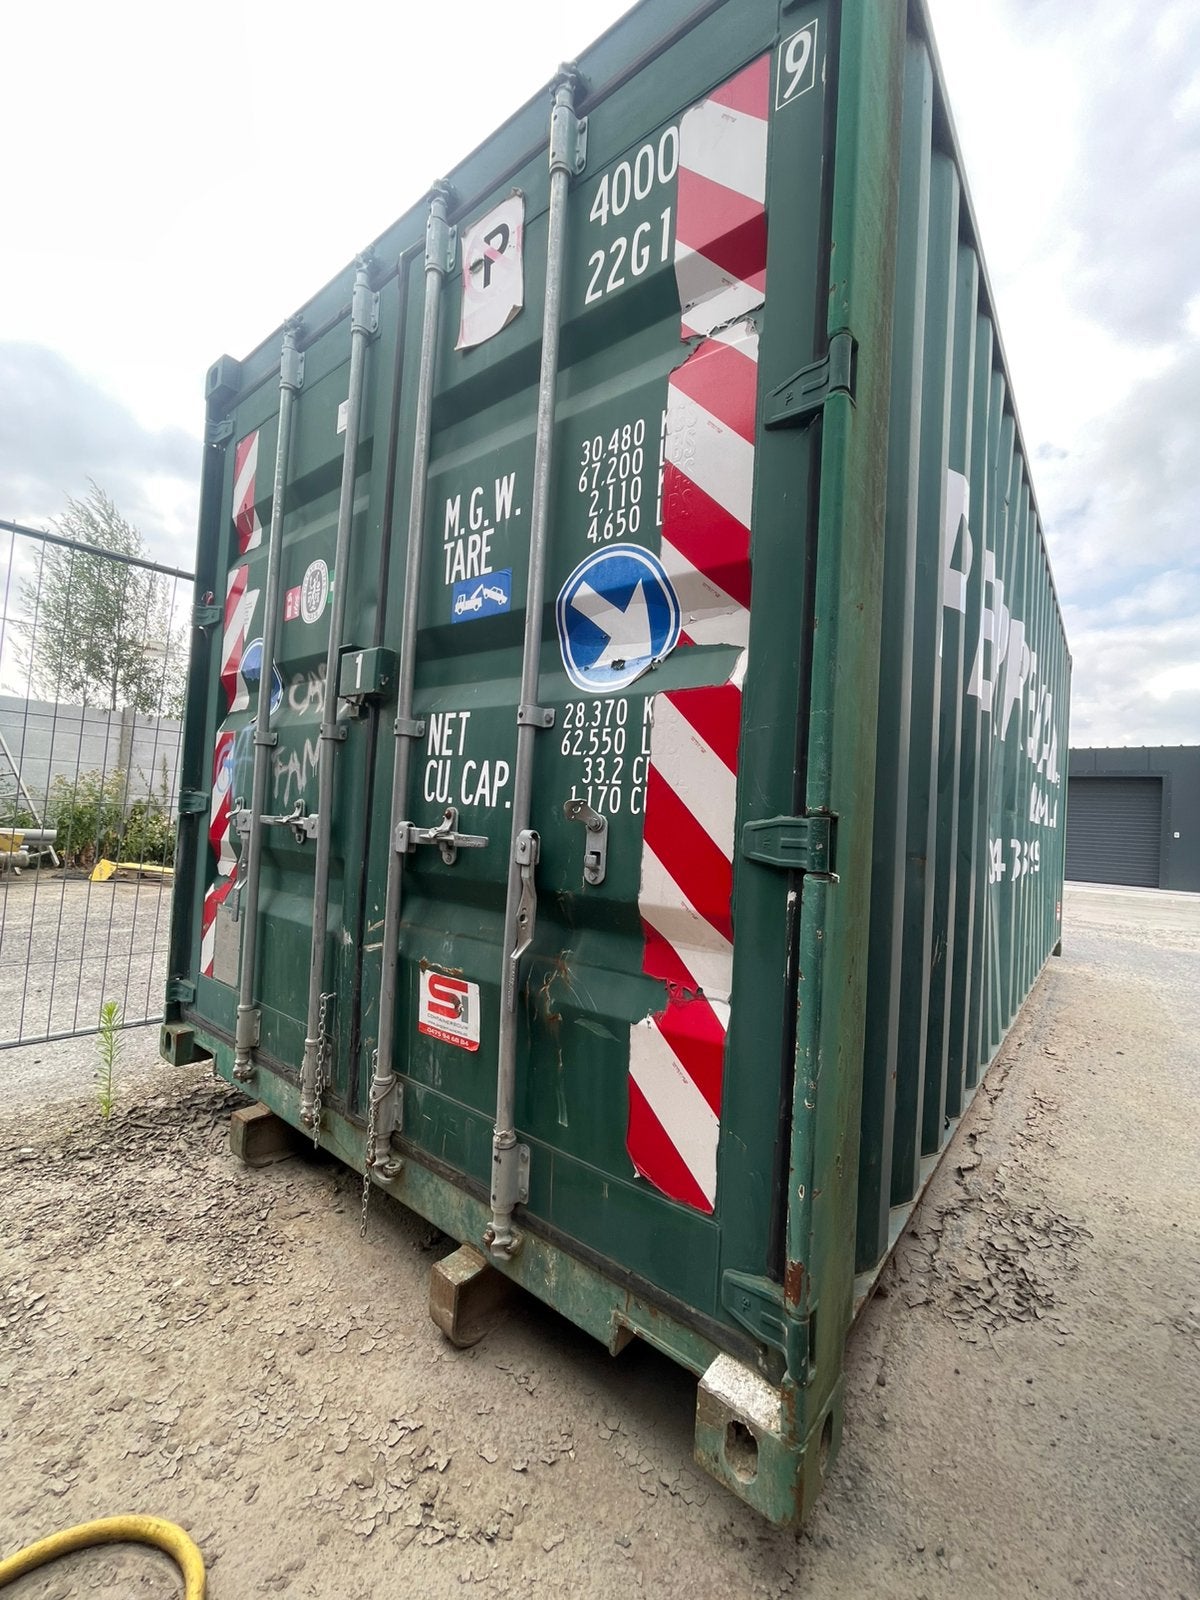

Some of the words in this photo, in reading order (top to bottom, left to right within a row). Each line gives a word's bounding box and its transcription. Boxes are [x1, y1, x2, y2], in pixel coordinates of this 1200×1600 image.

[783, 30, 812, 99] 9
[589, 125, 679, 227] 4000
[585, 206, 671, 305] 22G1
[443, 528, 495, 585] TARE
[355, 653, 364, 689] 1
[427, 711, 471, 757] NET
[424, 759, 454, 805] CU.
[460, 760, 511, 809] CAP.
[581, 756, 623, 784] 33.2
